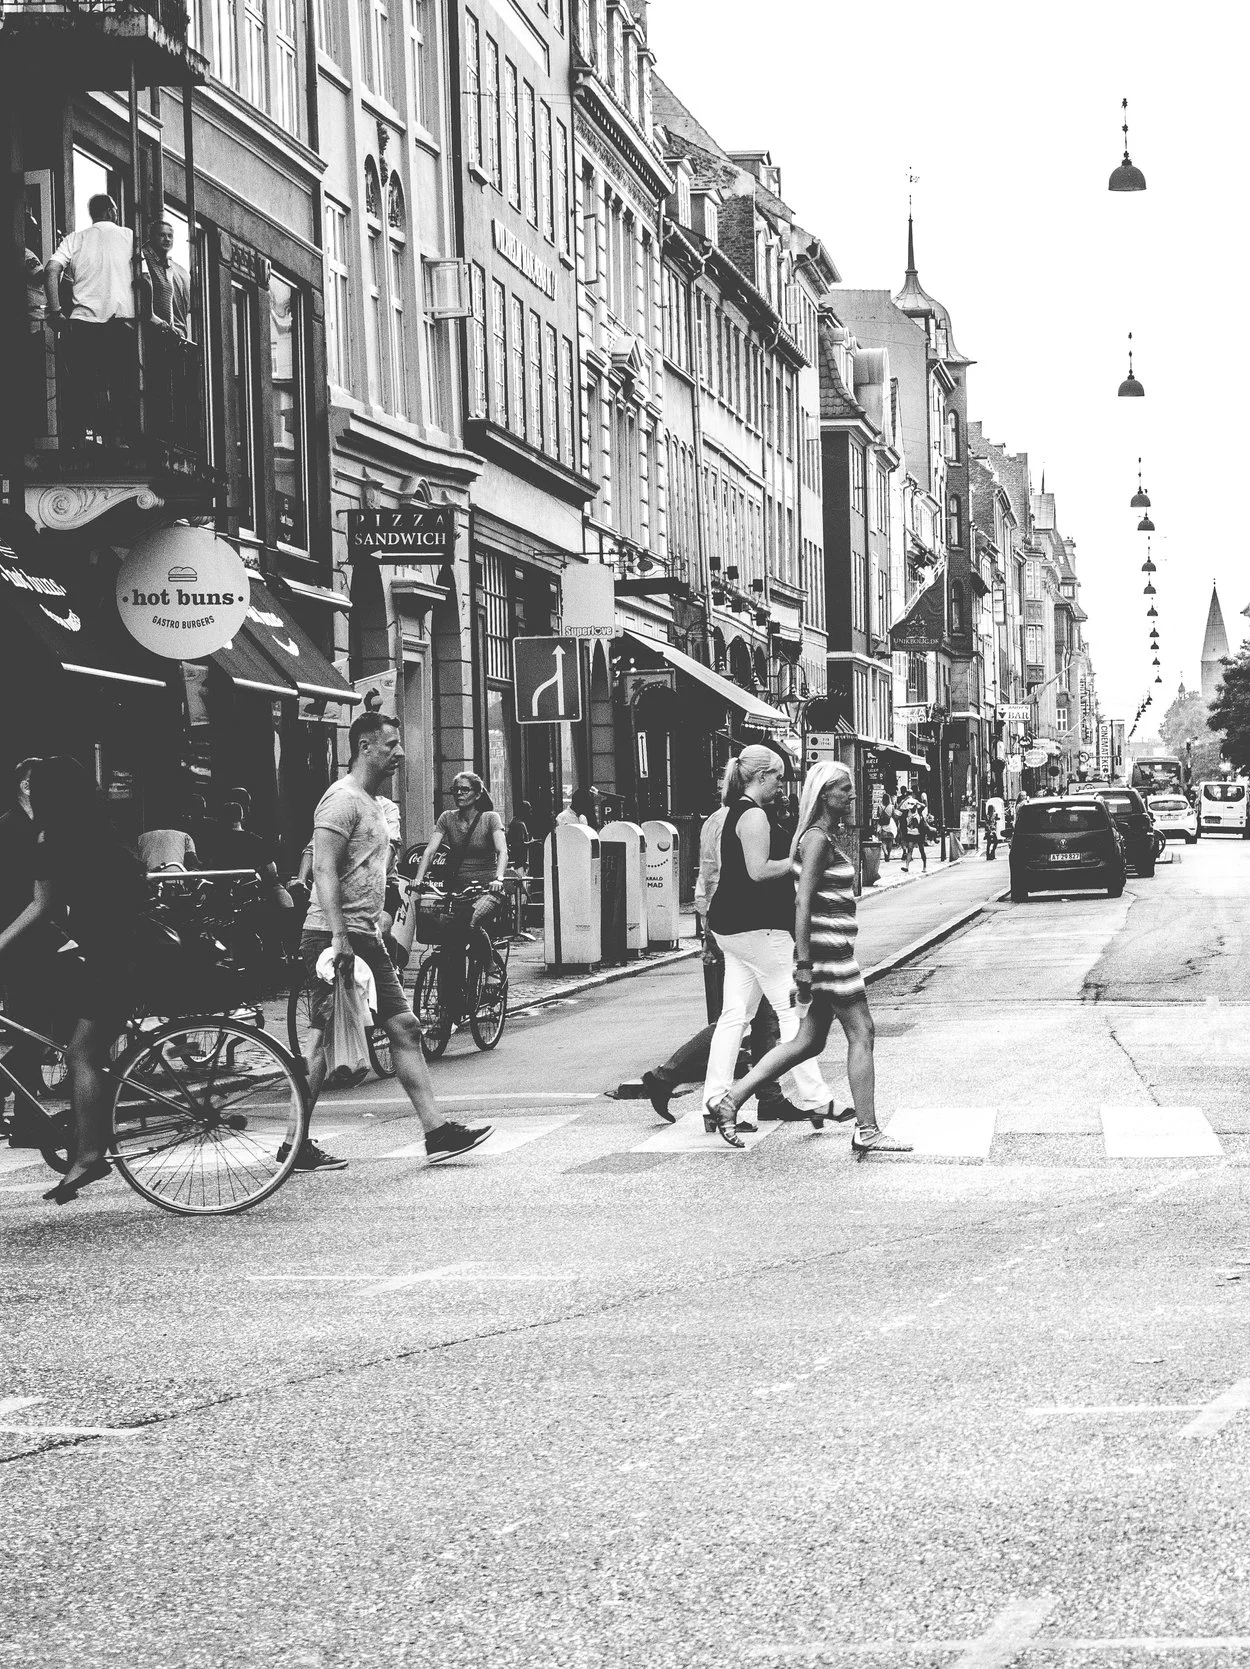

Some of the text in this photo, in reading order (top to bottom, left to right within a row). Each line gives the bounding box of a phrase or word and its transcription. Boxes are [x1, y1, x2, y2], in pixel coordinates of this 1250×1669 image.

[356, 513, 445, 527] PIZZA
[354, 532, 447, 546] SANDWICH
[131, 588, 234, 606] hot buns
[152, 615, 215, 630] GASTRO BURGERS
[1008, 711, 1029, 720] BAR
[1100, 725, 1109, 773] CINEMATEKE
